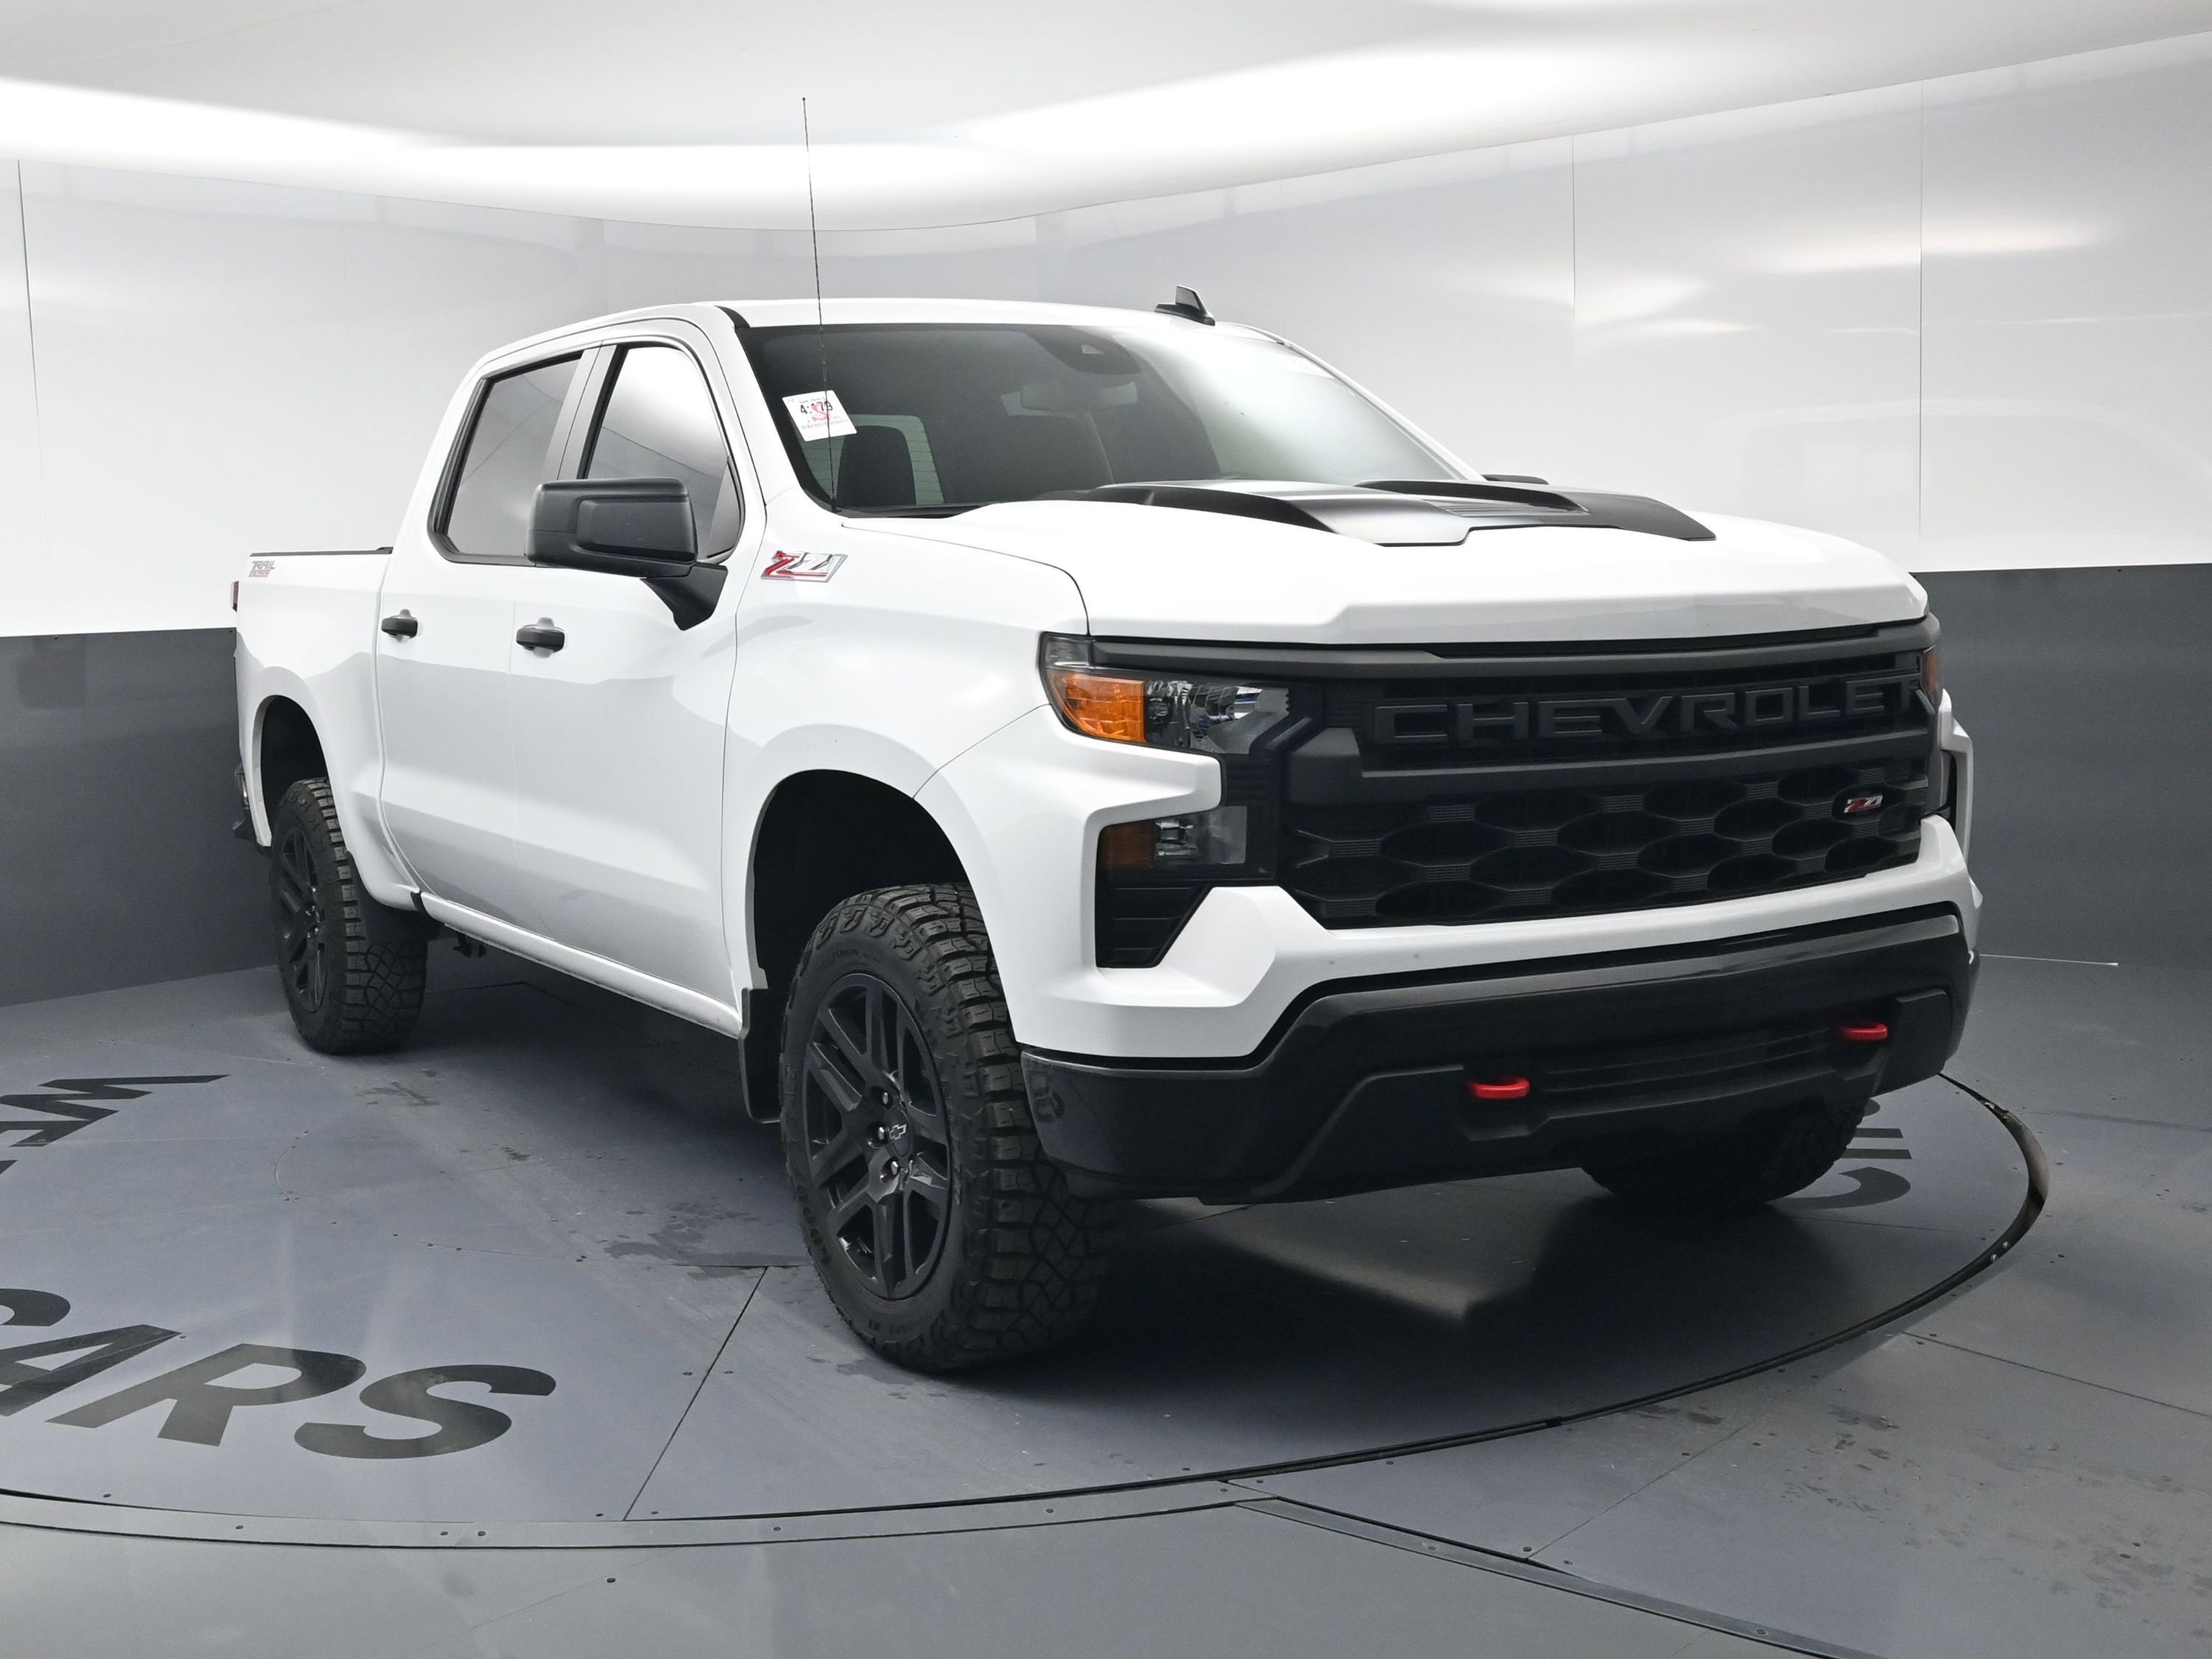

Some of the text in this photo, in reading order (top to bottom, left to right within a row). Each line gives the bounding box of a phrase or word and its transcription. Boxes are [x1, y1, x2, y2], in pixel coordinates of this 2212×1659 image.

[251, 560, 275, 569] TRAIL
[761, 550, 848, 582] Z71
[1844, 795, 1883, 813] Z71
